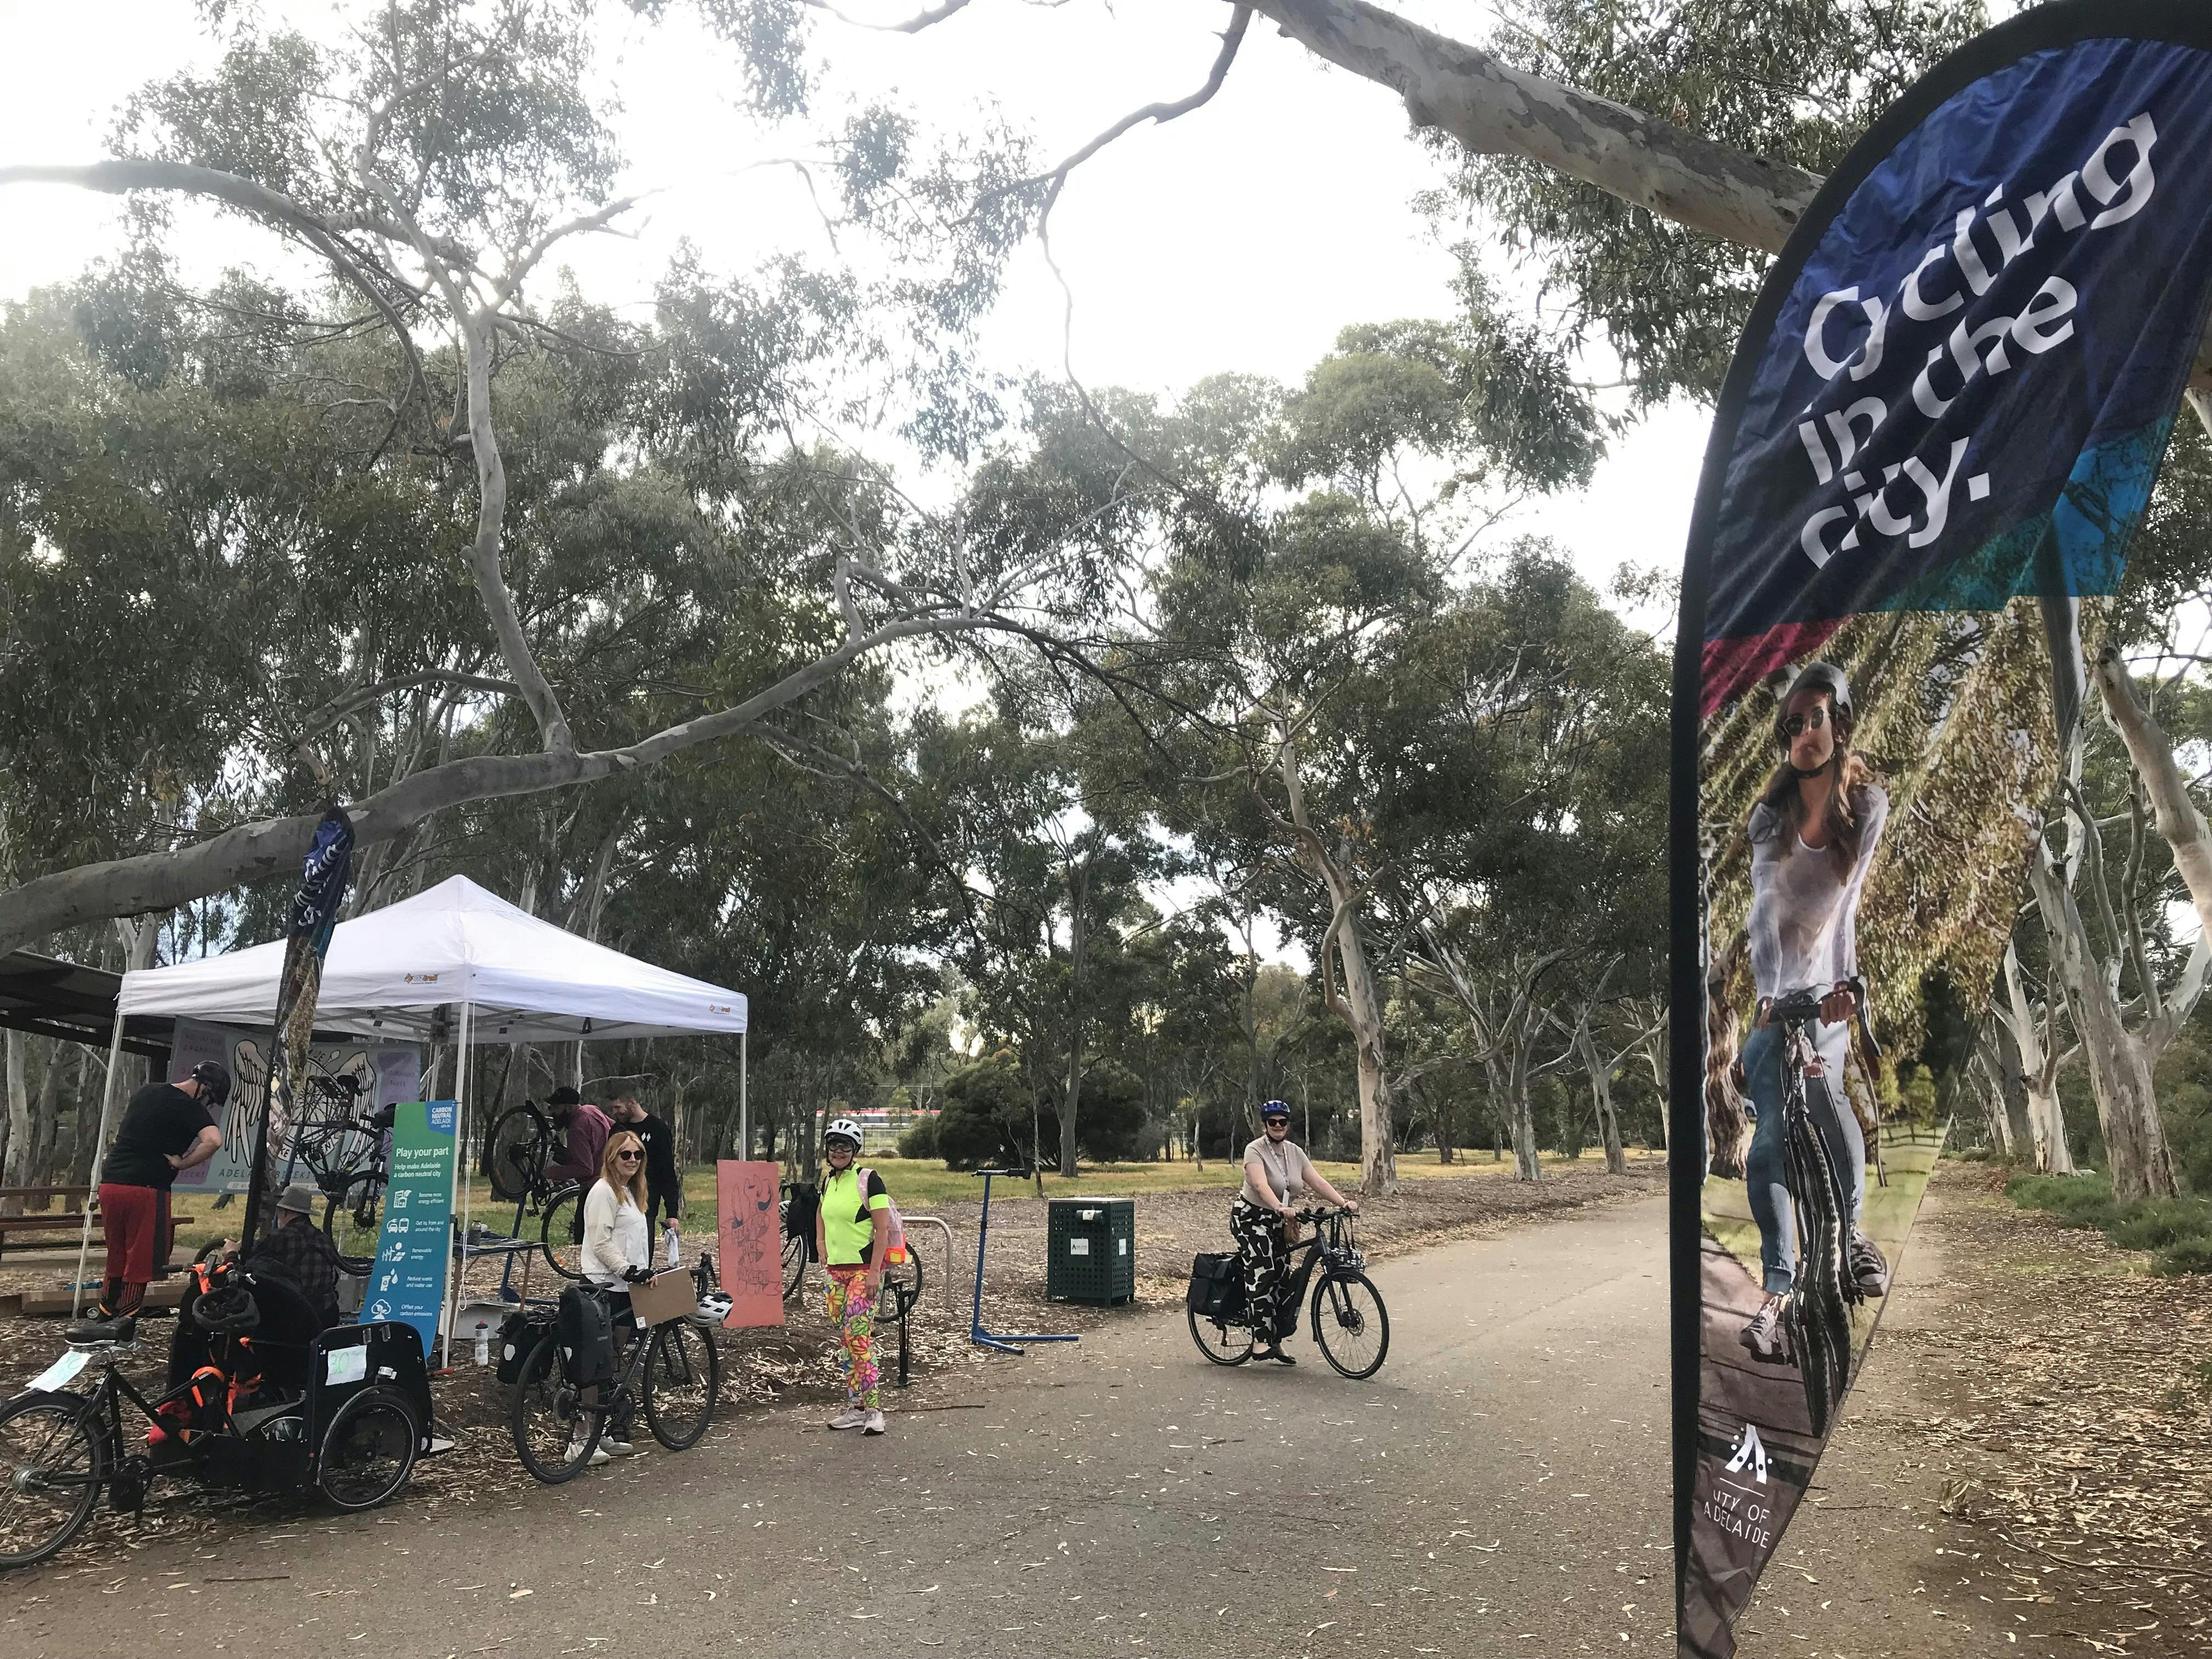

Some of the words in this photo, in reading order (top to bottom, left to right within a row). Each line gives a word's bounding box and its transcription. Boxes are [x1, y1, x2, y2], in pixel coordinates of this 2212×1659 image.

[1804, 111, 2158, 381] Cycling
[1798, 396, 1887, 485] in
[1912, 275, 2078, 419] the
[1801, 436, 1990, 569] city.
[396, 1148, 412, 1159] Play
[414, 1149, 432, 1159] your
[433, 1147, 449, 1158] part
[331, 1352, 349, 1374] 30
[1703, 1502, 1770, 1548] ADELAIDE
[1748, 1504, 1770, 1524] OF
